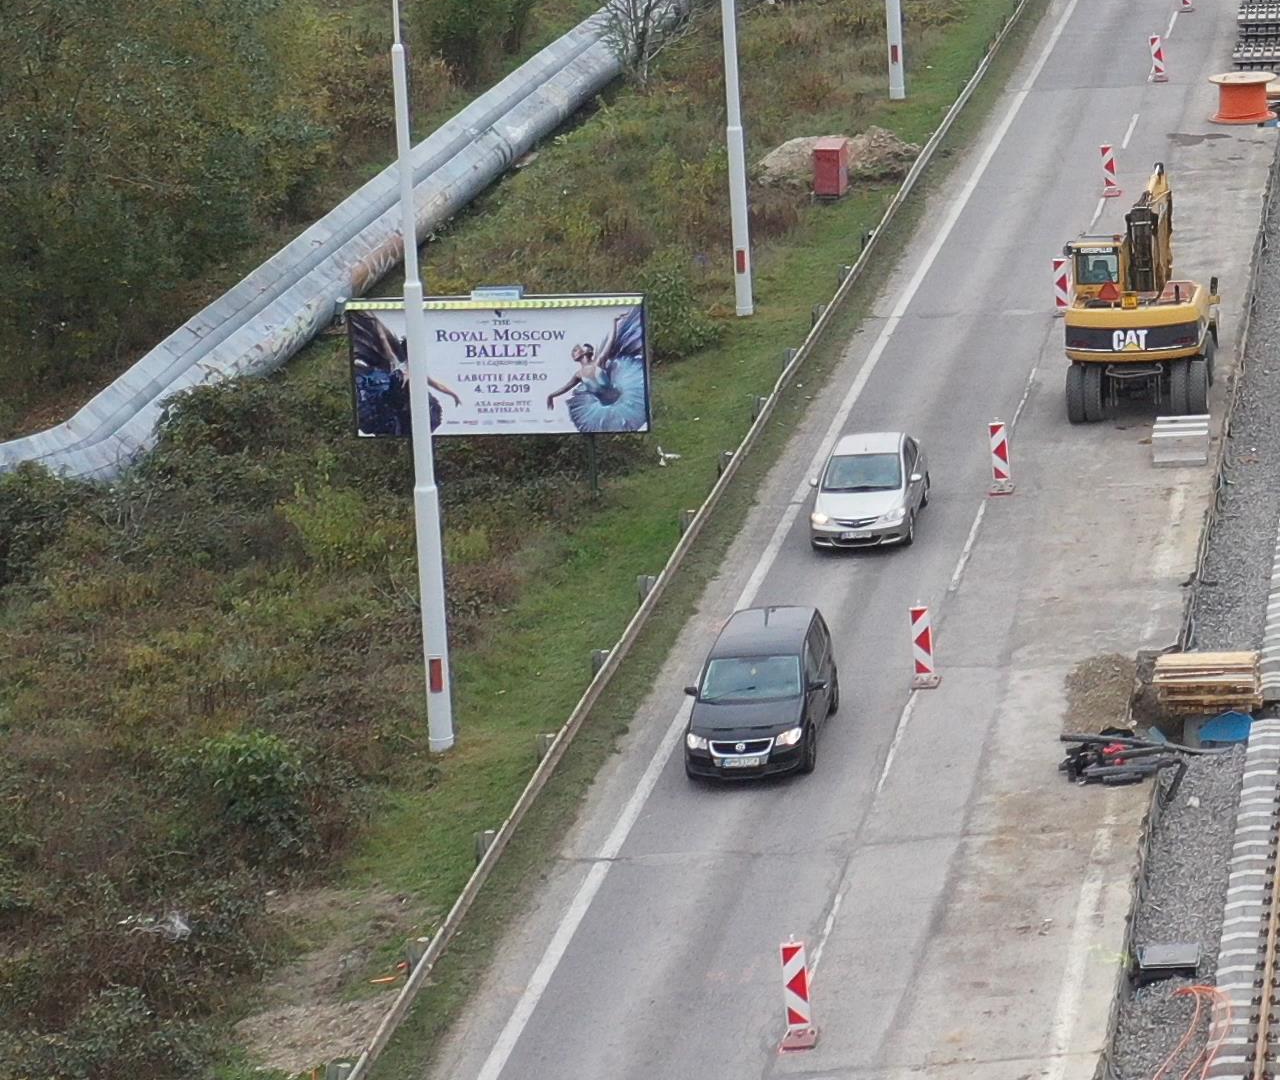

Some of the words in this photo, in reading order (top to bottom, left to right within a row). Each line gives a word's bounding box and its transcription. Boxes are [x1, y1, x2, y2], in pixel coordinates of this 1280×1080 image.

[436, 329, 488, 342] ROYAL
[493, 328, 566, 341] MOSCOW
[1112, 330, 1148, 351] CAT
[465, 344, 541, 358] BALLET
[457, 374, 503, 382] LABUTIE
[507, 373, 548, 382] JAZERO
[504, 384, 531, 393] 2019
